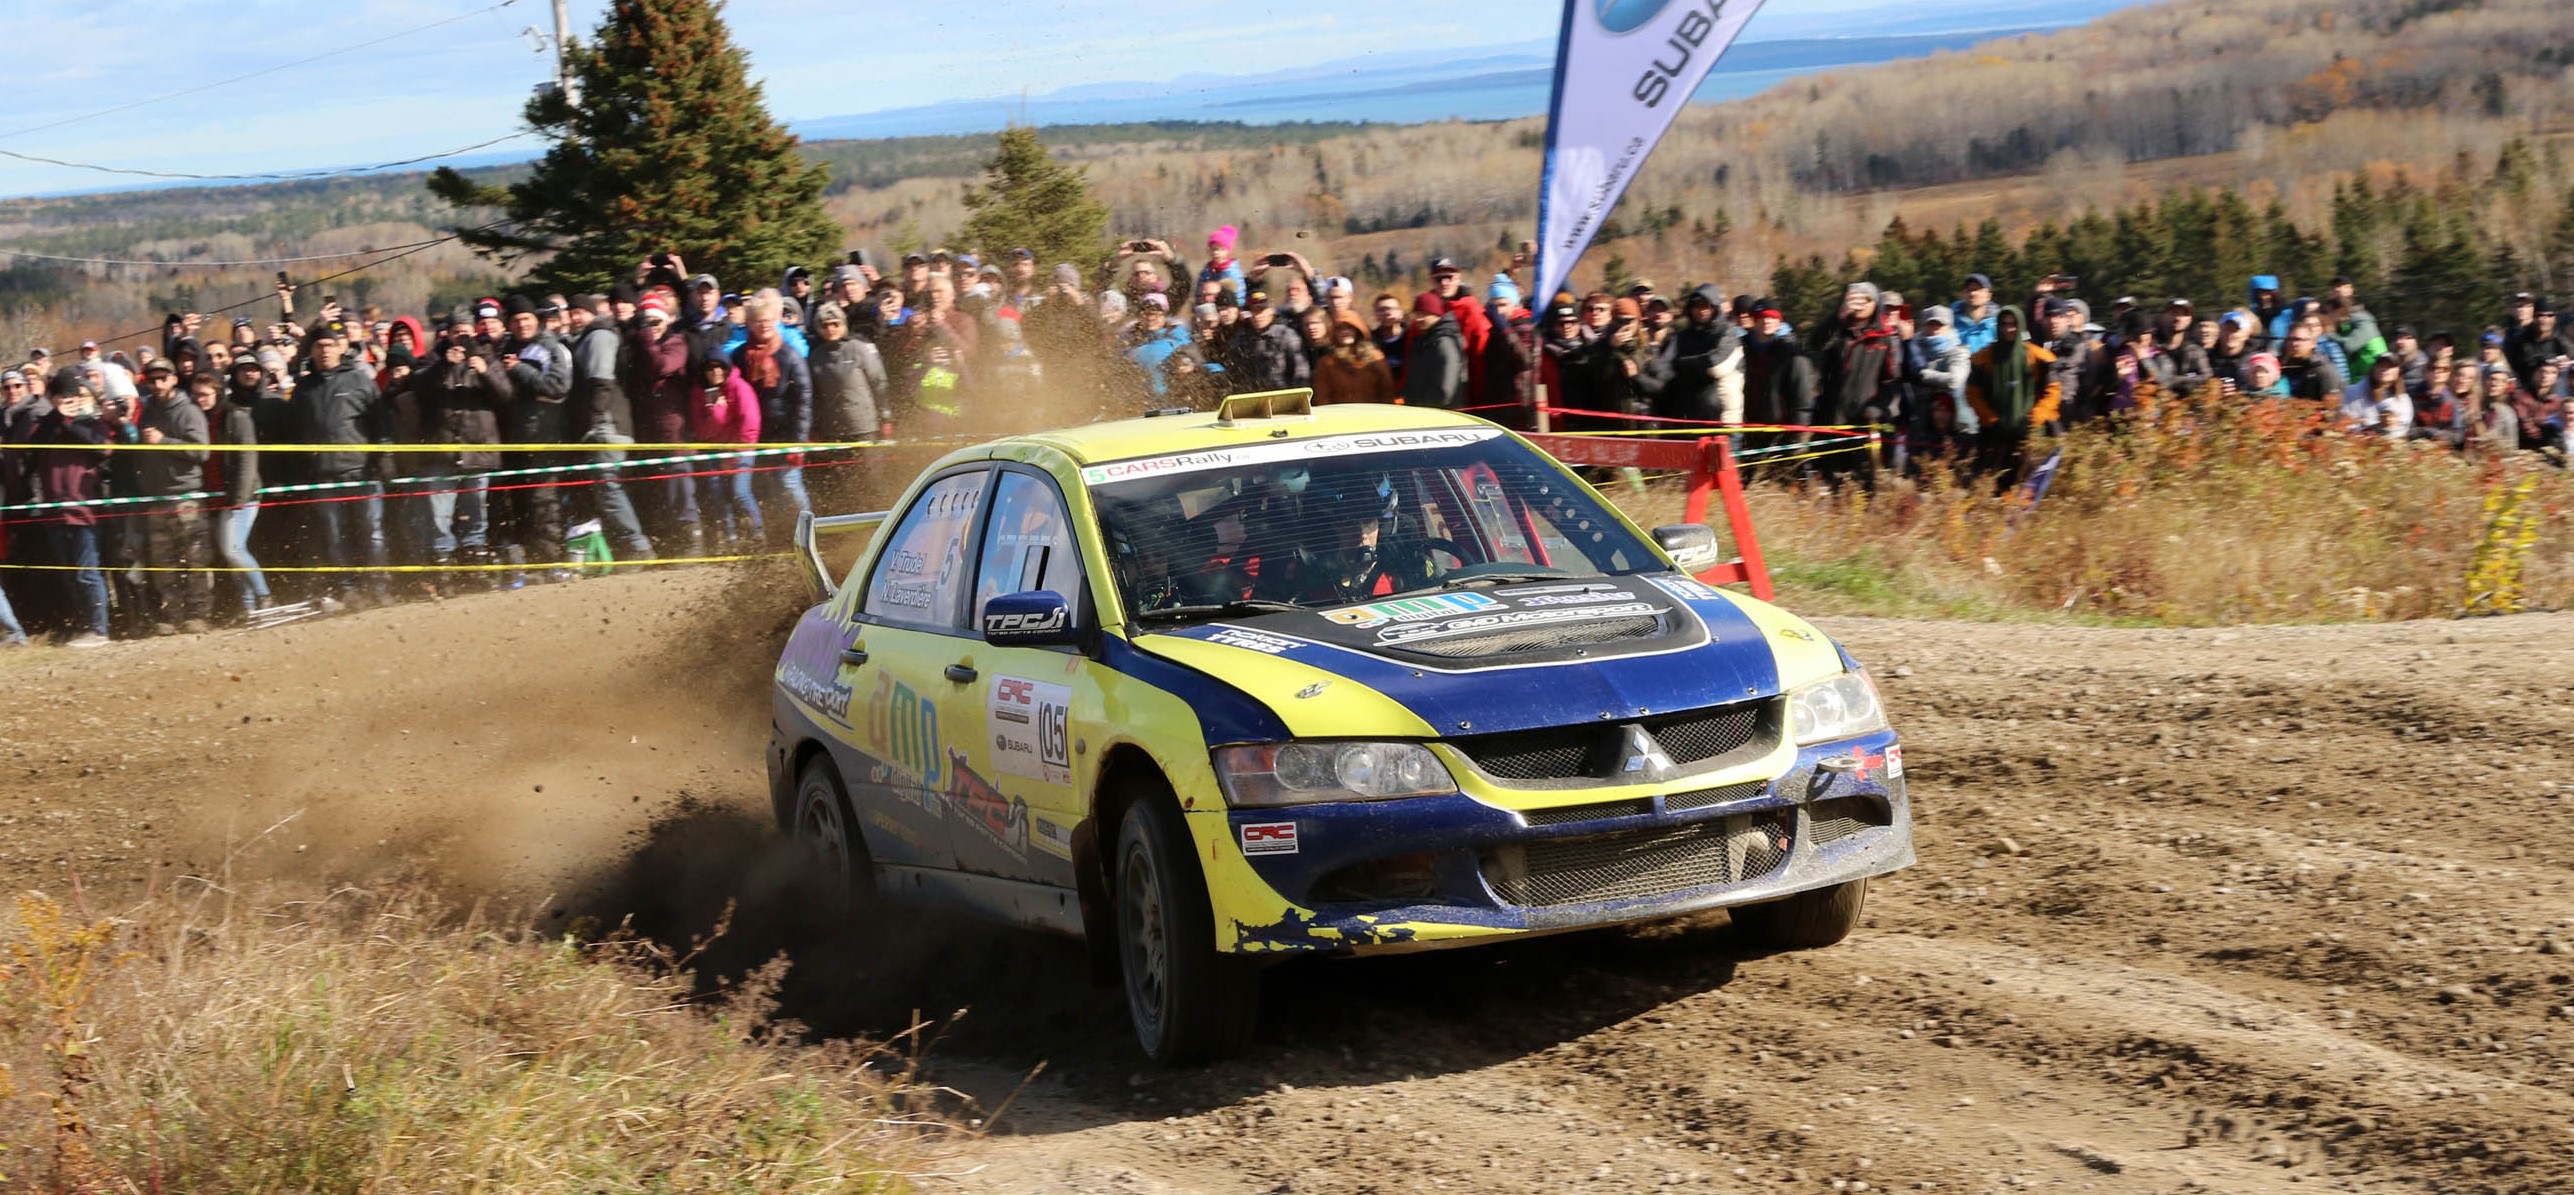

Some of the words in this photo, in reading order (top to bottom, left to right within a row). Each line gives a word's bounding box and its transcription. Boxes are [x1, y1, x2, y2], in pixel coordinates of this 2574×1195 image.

[1353, 433, 1482, 448] SUBARU
[1501, 603, 1654, 624] Motorsport
[1205, 633, 1287, 654] TYRES
[1007, 739, 1033, 754] SUBARU
[1244, 824, 1295, 841] CRC
